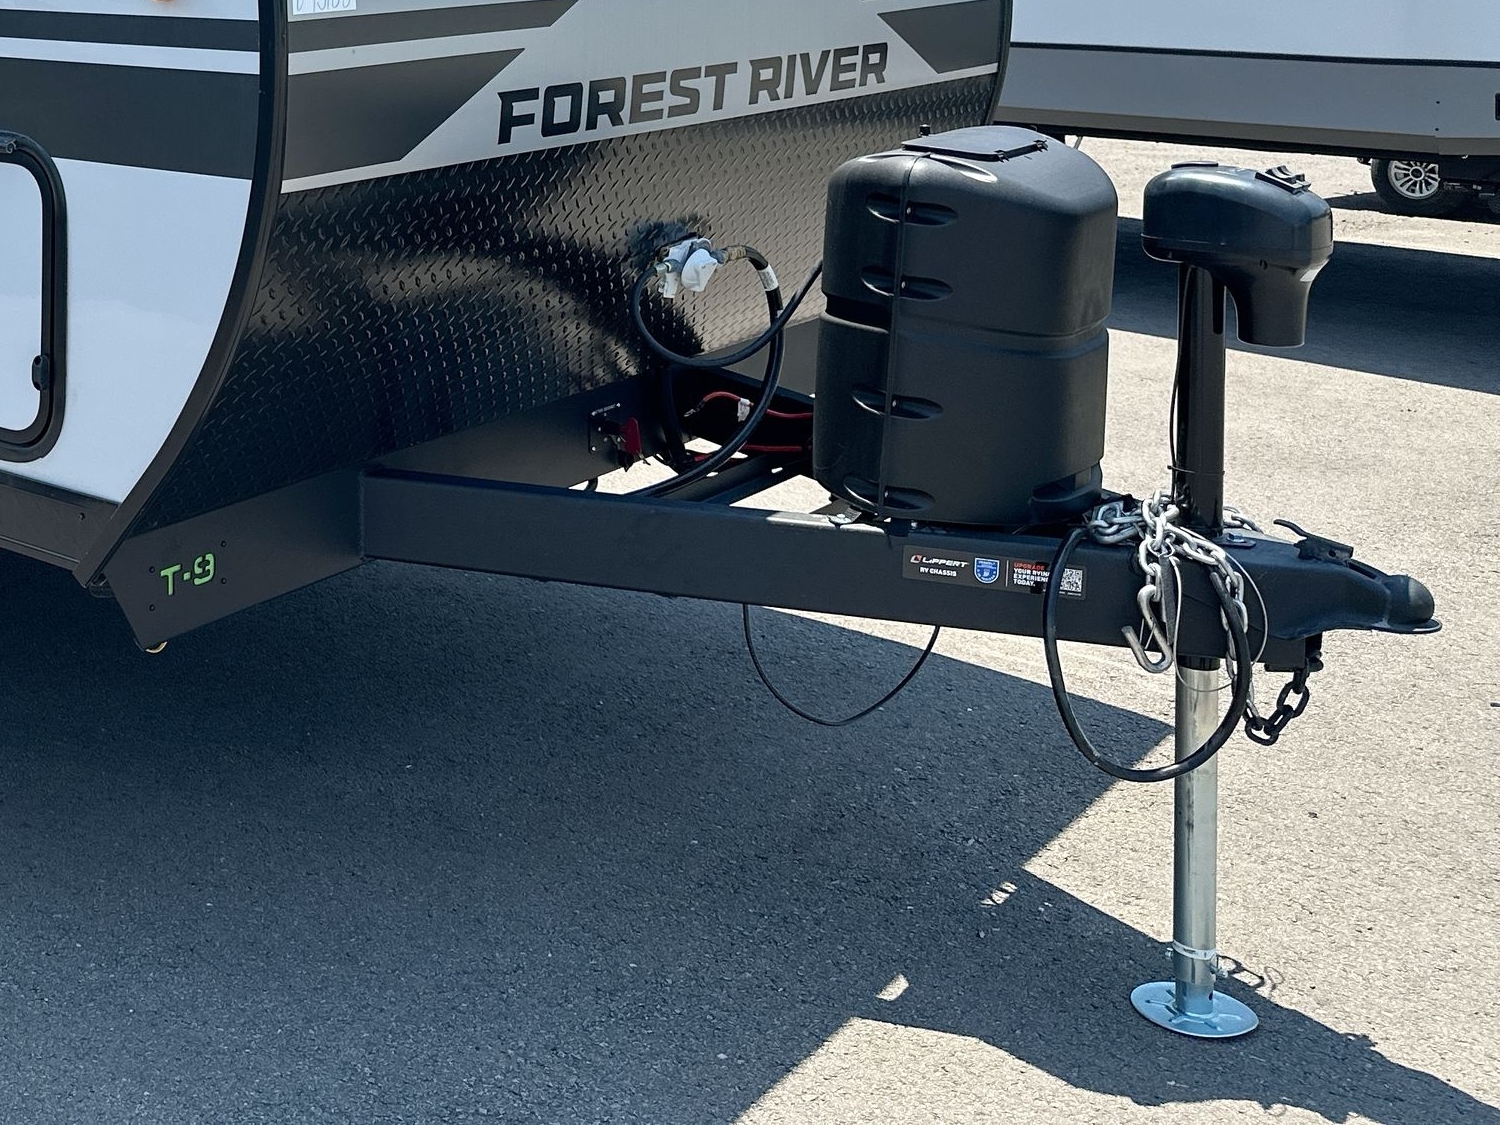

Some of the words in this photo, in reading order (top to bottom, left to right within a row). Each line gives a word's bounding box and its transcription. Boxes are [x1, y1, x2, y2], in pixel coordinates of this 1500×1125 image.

[496, 60, 738, 145] FOREST
[748, 41, 888, 106] RIVER
[919, 566, 929, 574] RV
[929, 567, 957, 577] CHASSIS
[1013, 567, 1031, 575] YOUR
[1013, 573, 1048, 583] EXPERIEN
